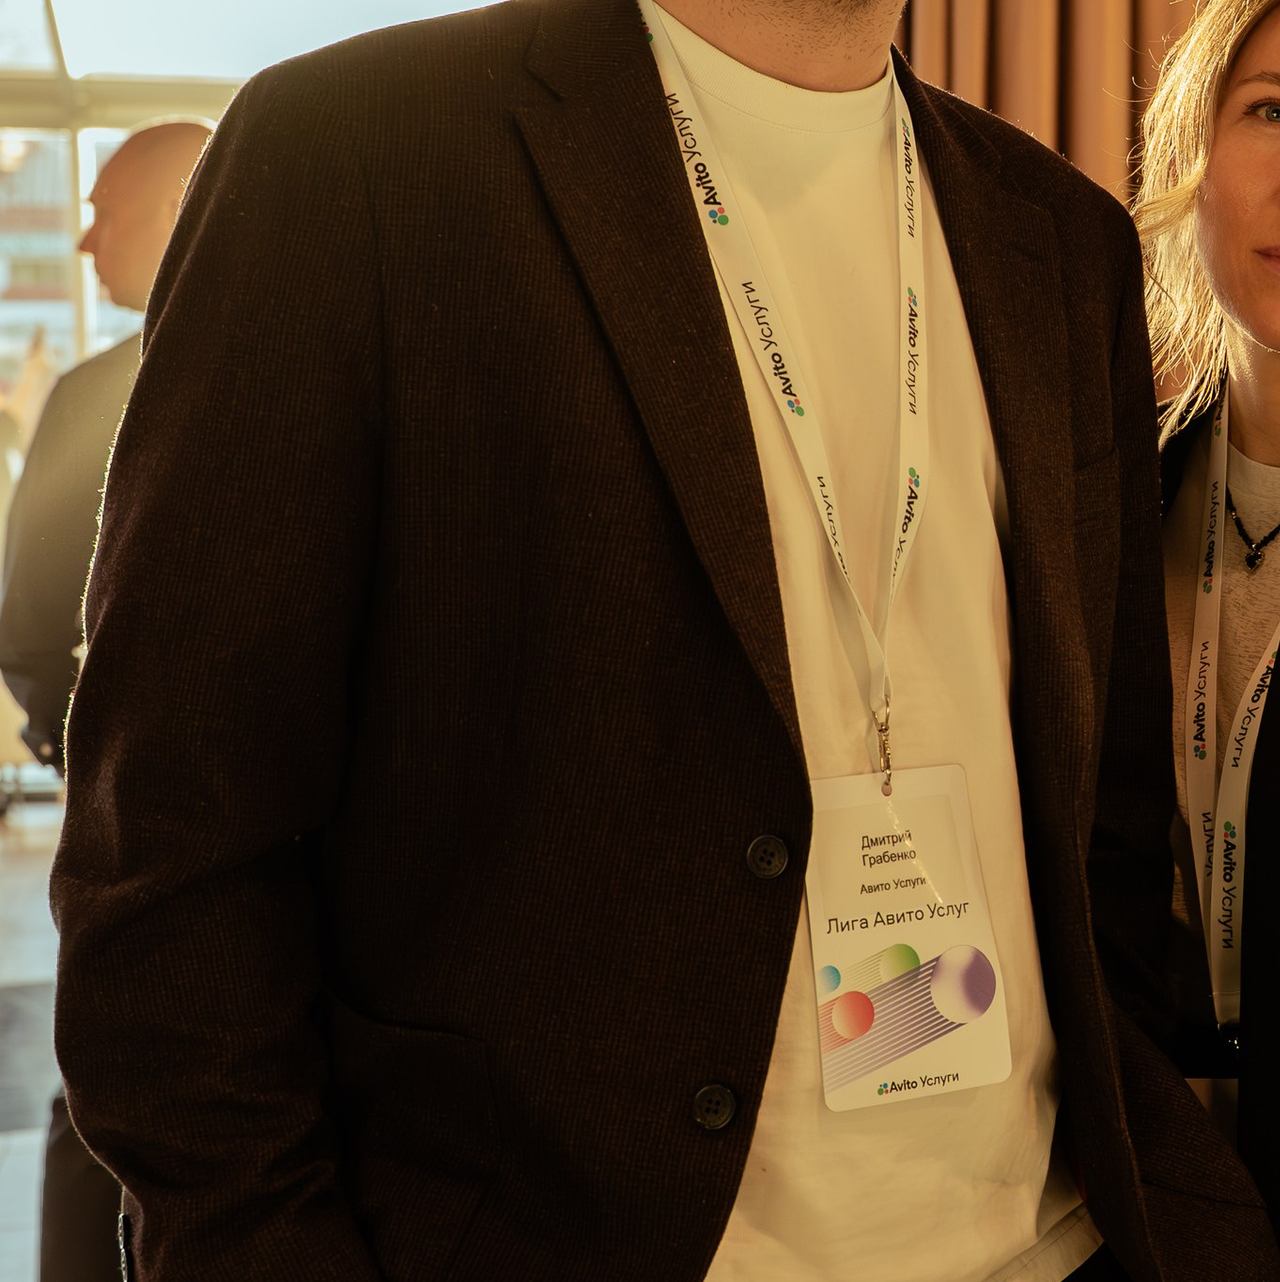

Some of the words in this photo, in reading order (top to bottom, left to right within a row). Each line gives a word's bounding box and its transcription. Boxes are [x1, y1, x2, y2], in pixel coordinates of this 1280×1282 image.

[665, 92, 702, 163] Услуги
[694, 162, 722, 206] Avito
[904, 175, 915, 238] Услуги
[741, 281, 778, 351] Услуги
[908, 303, 919, 349] Avito
[771, 352, 797, 398] Avito
[905, 349, 919, 415] Услуги
[901, 485, 919, 534] Avito
[1194, 640, 1210, 702] Услуги
[1193, 702, 1206, 742] Avito
[1231, 706, 1260, 768] Услуги
[861, 829, 912, 851] Дмитрий
[861, 849, 917, 868] Грабенко
[1222, 839, 1237, 883] Avito
[859, 882, 891, 895] Авито
[892, 876, 927, 890] Услуги
[826, 917, 869, 935] Лига
[873, 910, 925, 928] Авито
[926, 901, 970, 919] Услуг
[1218, 886, 1237, 949] Услуги
[889, 1079, 918, 1094] Avito
[919, 1072, 960, 1088] Услуги
